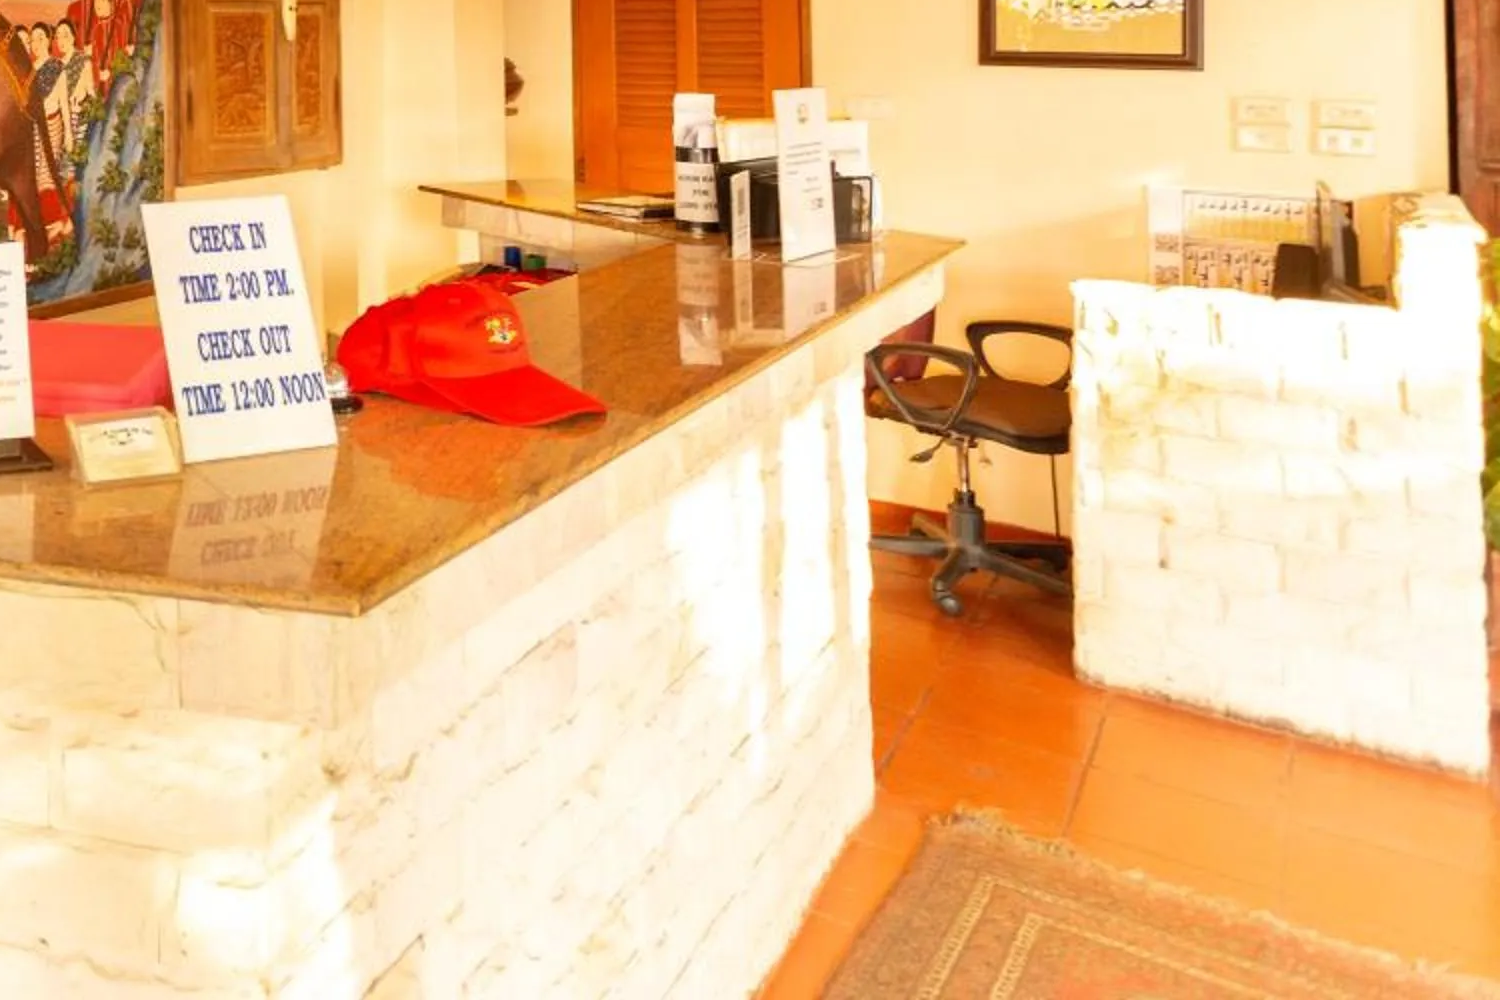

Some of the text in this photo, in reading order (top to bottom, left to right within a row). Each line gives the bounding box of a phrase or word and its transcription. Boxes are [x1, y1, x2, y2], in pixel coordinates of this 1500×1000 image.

[189, 221, 267, 254] CHECK IN
[179, 269, 295, 304] TIME 2:00 PM.
[197, 325, 292, 362] CHECK OUT
[182, 371, 327, 416] TIME 12:00 NOON
